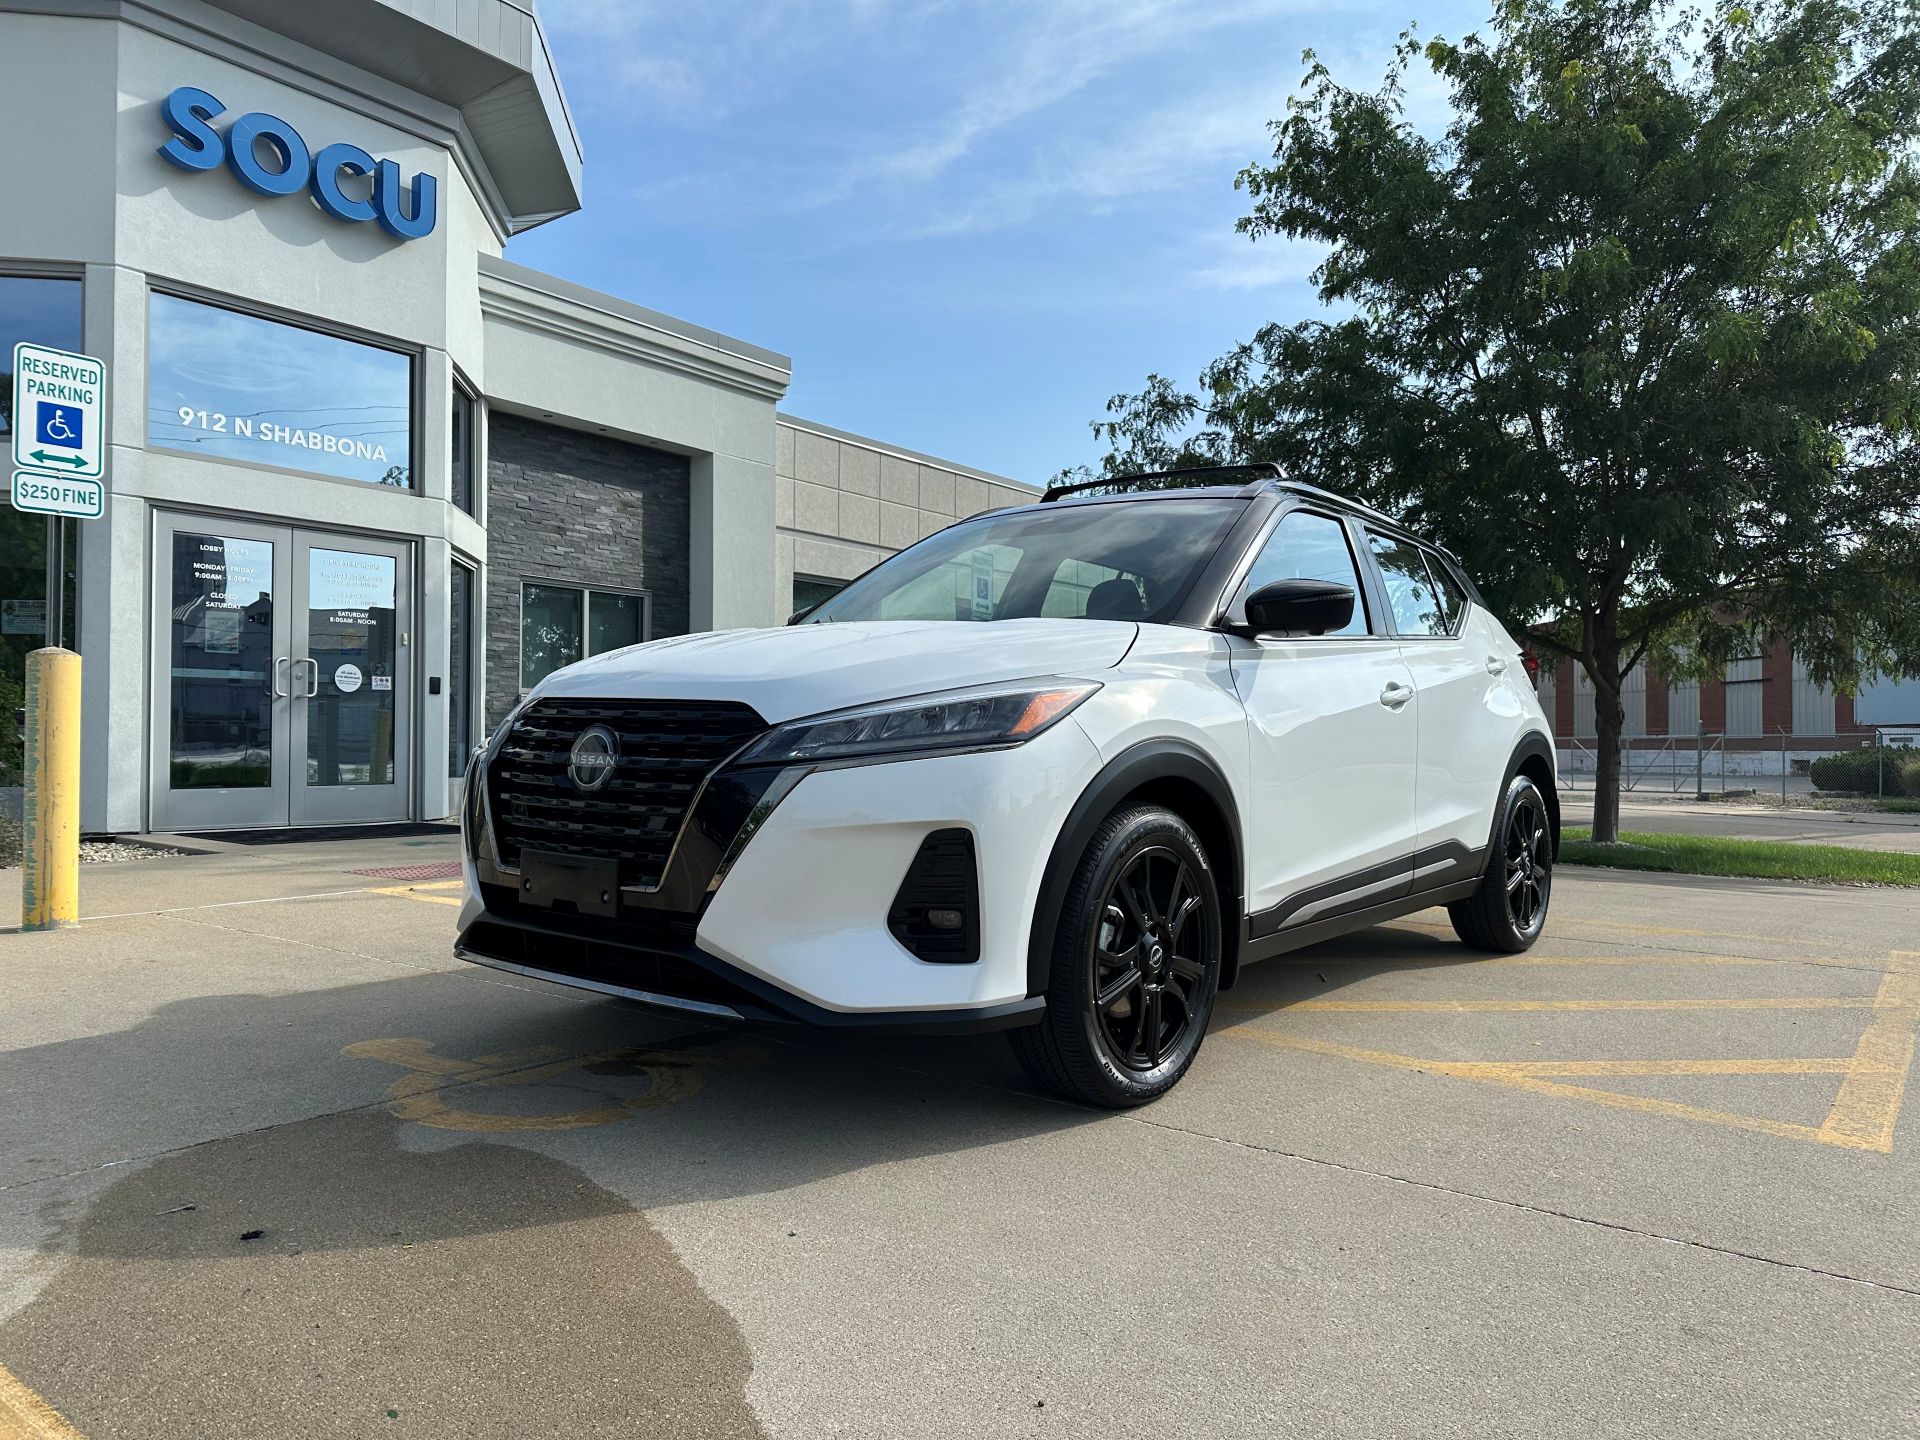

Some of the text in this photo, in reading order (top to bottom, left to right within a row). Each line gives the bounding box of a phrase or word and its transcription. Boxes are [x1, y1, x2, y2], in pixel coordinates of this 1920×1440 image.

[158, 86, 437, 239] SOCU
[22, 356, 98, 385] RESERVED
[27, 379, 93, 405] PARKING
[178, 406, 387, 463] 912 N SHABBONA
[19, 481, 97, 506] $250 FINE
[200, 544, 223, 552] LOBBY
[193, 562, 226, 571] MONDAY
[194, 571, 222, 580] 9:00AM
[210, 592, 237, 600] CLOSED
[205, 601, 241, 610] SATURDAY
[337, 610, 369, 619] SATURDAY
[357, 618, 377, 626] NOON
[571, 753, 616, 765] NISSAN
